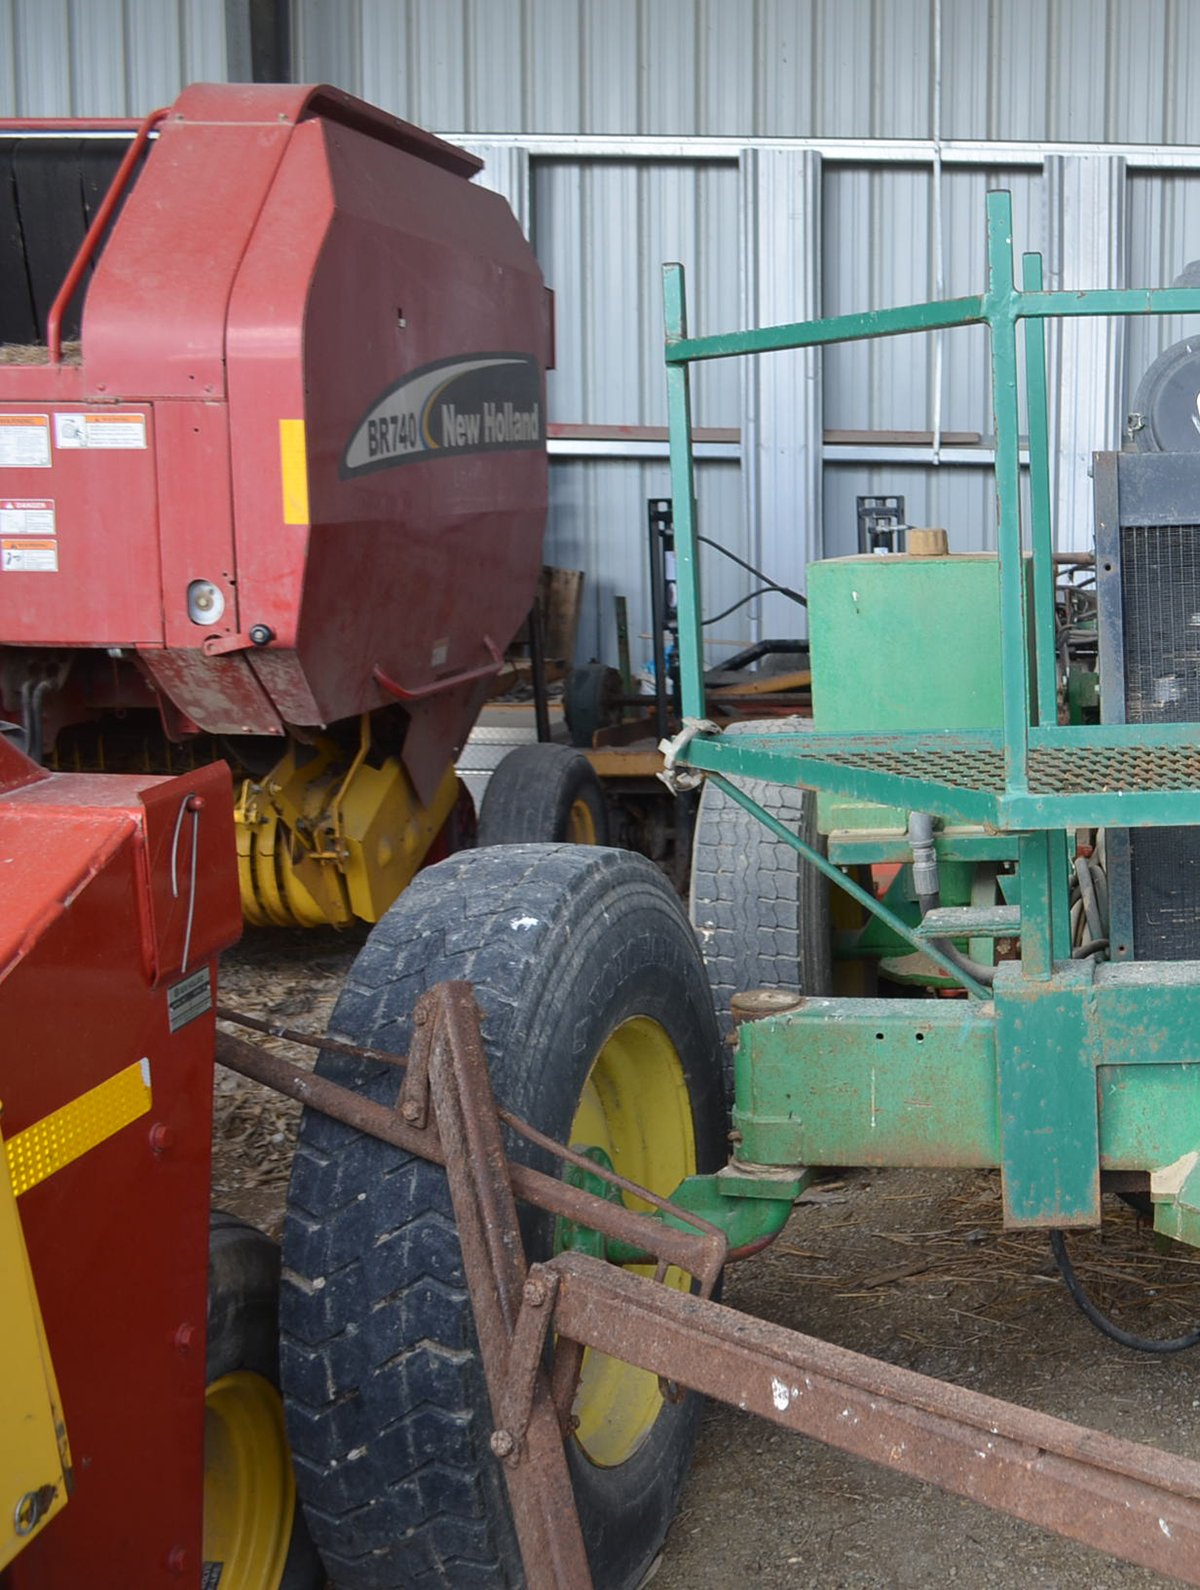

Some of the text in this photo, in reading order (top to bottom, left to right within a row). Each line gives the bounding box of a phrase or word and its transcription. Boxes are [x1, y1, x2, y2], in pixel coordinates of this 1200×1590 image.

[368, 413, 417, 457] BR740
[441, 402, 539, 447] New Holland
